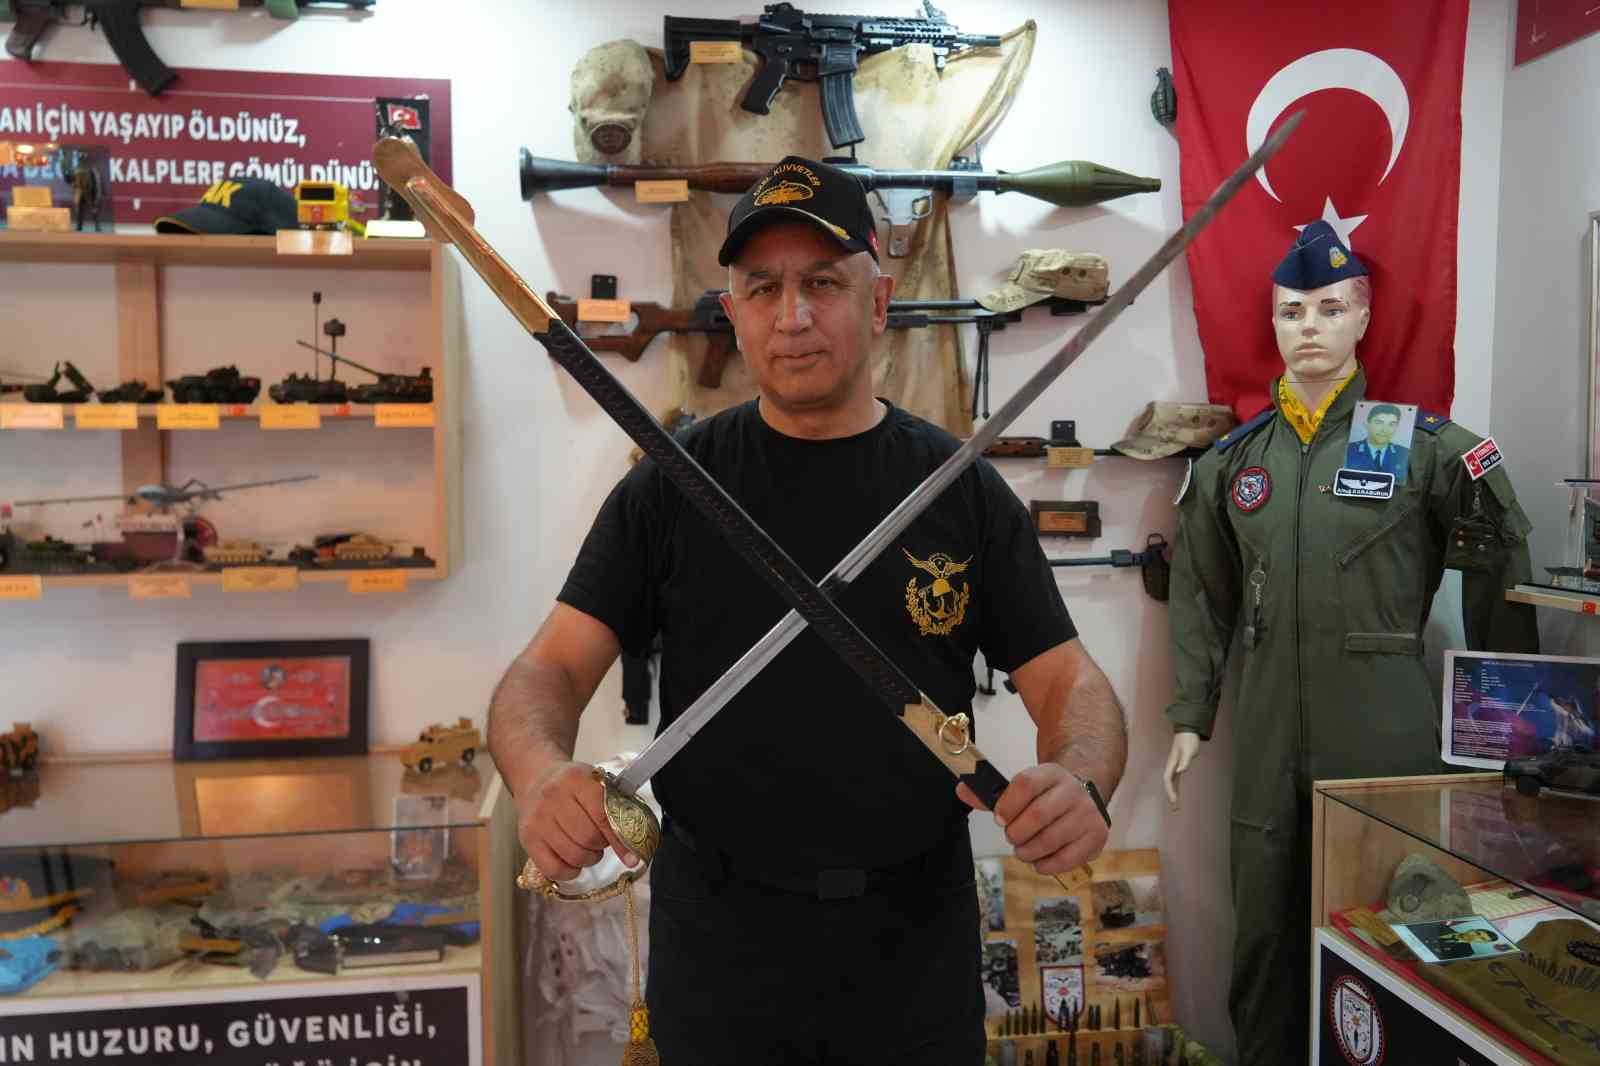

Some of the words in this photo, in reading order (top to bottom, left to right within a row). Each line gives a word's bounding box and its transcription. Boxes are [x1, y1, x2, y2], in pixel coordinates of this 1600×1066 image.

[36, 102, 86, 141] İÇİN
[89, 111, 185, 144] YAŞAYIP
[188, 110, 307, 148] ÖLDÜNÜZ,
[109, 157, 225, 185] KALPLERE
[49, 1023, 214, 1059] HUZURU,
[228, 1002, 437, 1048] GÜVENLİĞİ,
